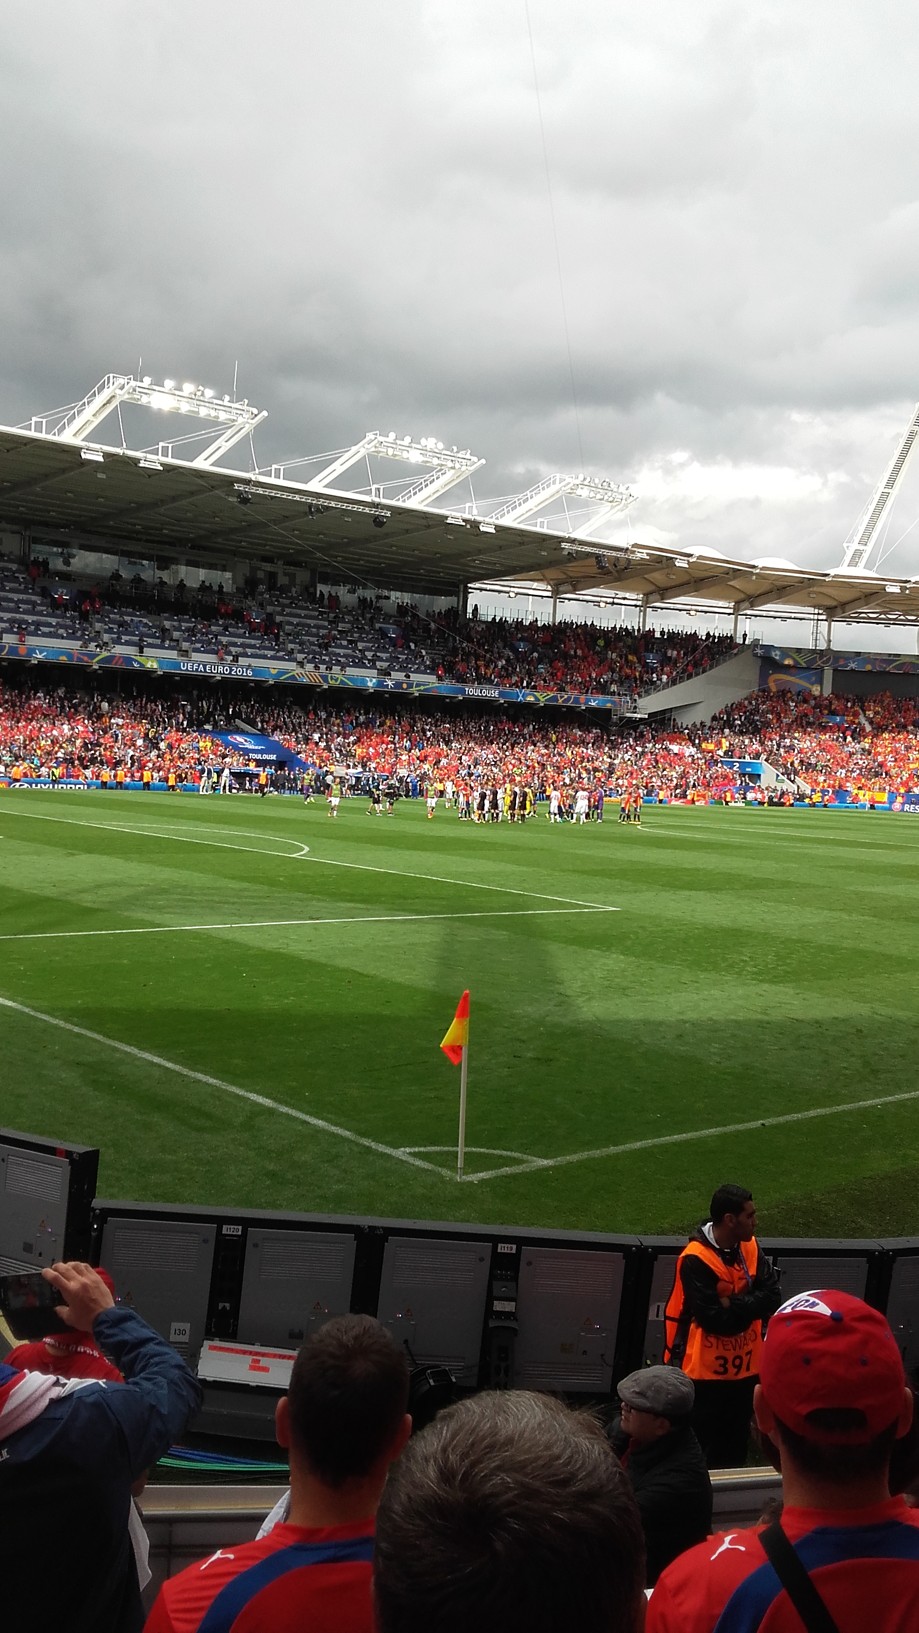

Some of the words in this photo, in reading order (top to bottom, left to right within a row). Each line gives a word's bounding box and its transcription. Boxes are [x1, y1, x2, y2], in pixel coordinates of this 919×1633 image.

[180, 662, 204, 672] UEFA
[206, 664, 230, 674] EURO
[231, 667, 253, 676] 2016
[465, 687, 500, 698] TOULOUSE
[249, 753, 277, 761] TOULOUSE
[733, 762, 740, 771] 2
[712, 1349, 753, 1377] 397
